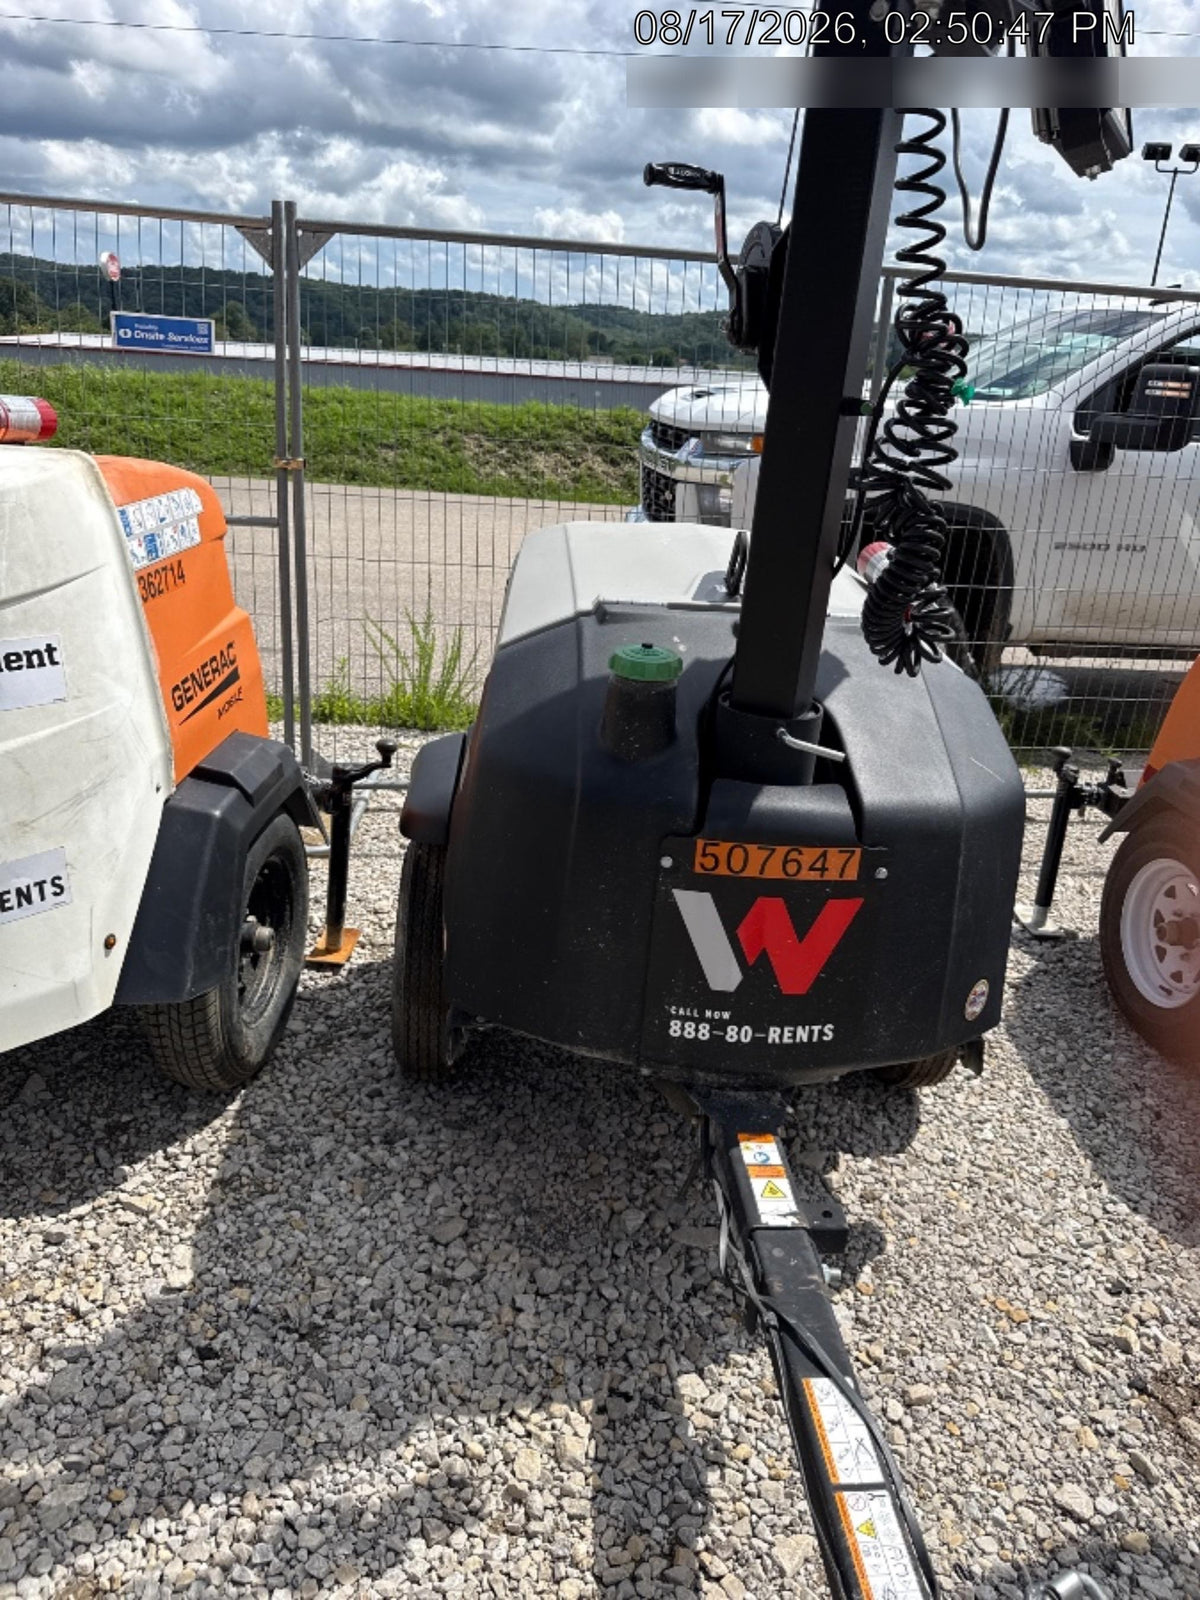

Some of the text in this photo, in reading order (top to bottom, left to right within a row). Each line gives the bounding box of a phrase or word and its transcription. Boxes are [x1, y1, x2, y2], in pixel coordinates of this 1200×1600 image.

[138, 559, 186, 602] 362714
[0, 643, 60, 672] ent
[171, 640, 237, 711] GENERAC
[699, 842, 856, 878] 507647
[669, 1005, 731, 1020] CALL NOW
[668, 1019, 835, 1045] 888-80-RENTS
